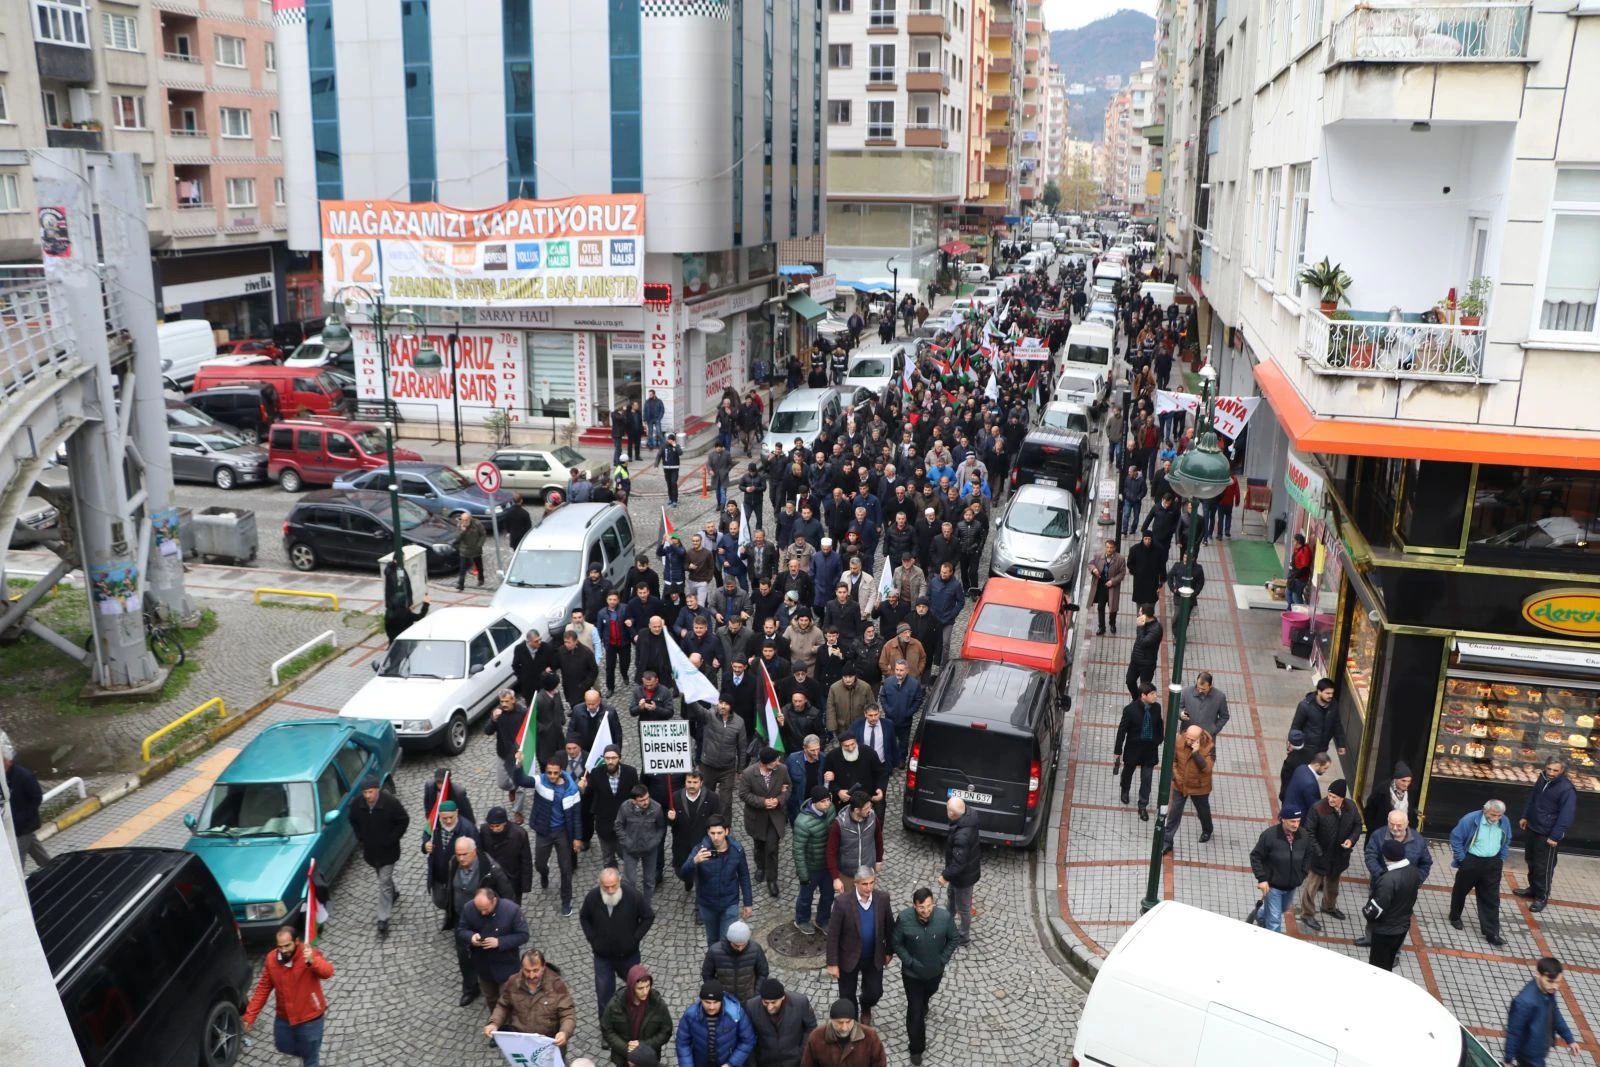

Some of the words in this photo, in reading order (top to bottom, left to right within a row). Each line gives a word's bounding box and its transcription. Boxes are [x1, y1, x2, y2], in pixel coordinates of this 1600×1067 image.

[329, 202, 467, 237] MAĞAZAMIZI
[472, 203, 637, 237] KAPATIYORUZ
[613, 242, 633, 253] YURT
[329, 242, 374, 283] 12
[546, 274, 639, 304] BAŞLAMIŞTIR
[479, 309, 516, 323] SARAY
[519, 310, 549, 324] HALI
[651, 321, 669, 386] İNDİRİM
[460, 373, 497, 408] SATIŞ
[669, 723, 688, 737] SELAM
[644, 740, 688, 755] DİRENİŞE
[650, 759, 685, 769] DEVAM
[964, 791, 975, 800] DN
